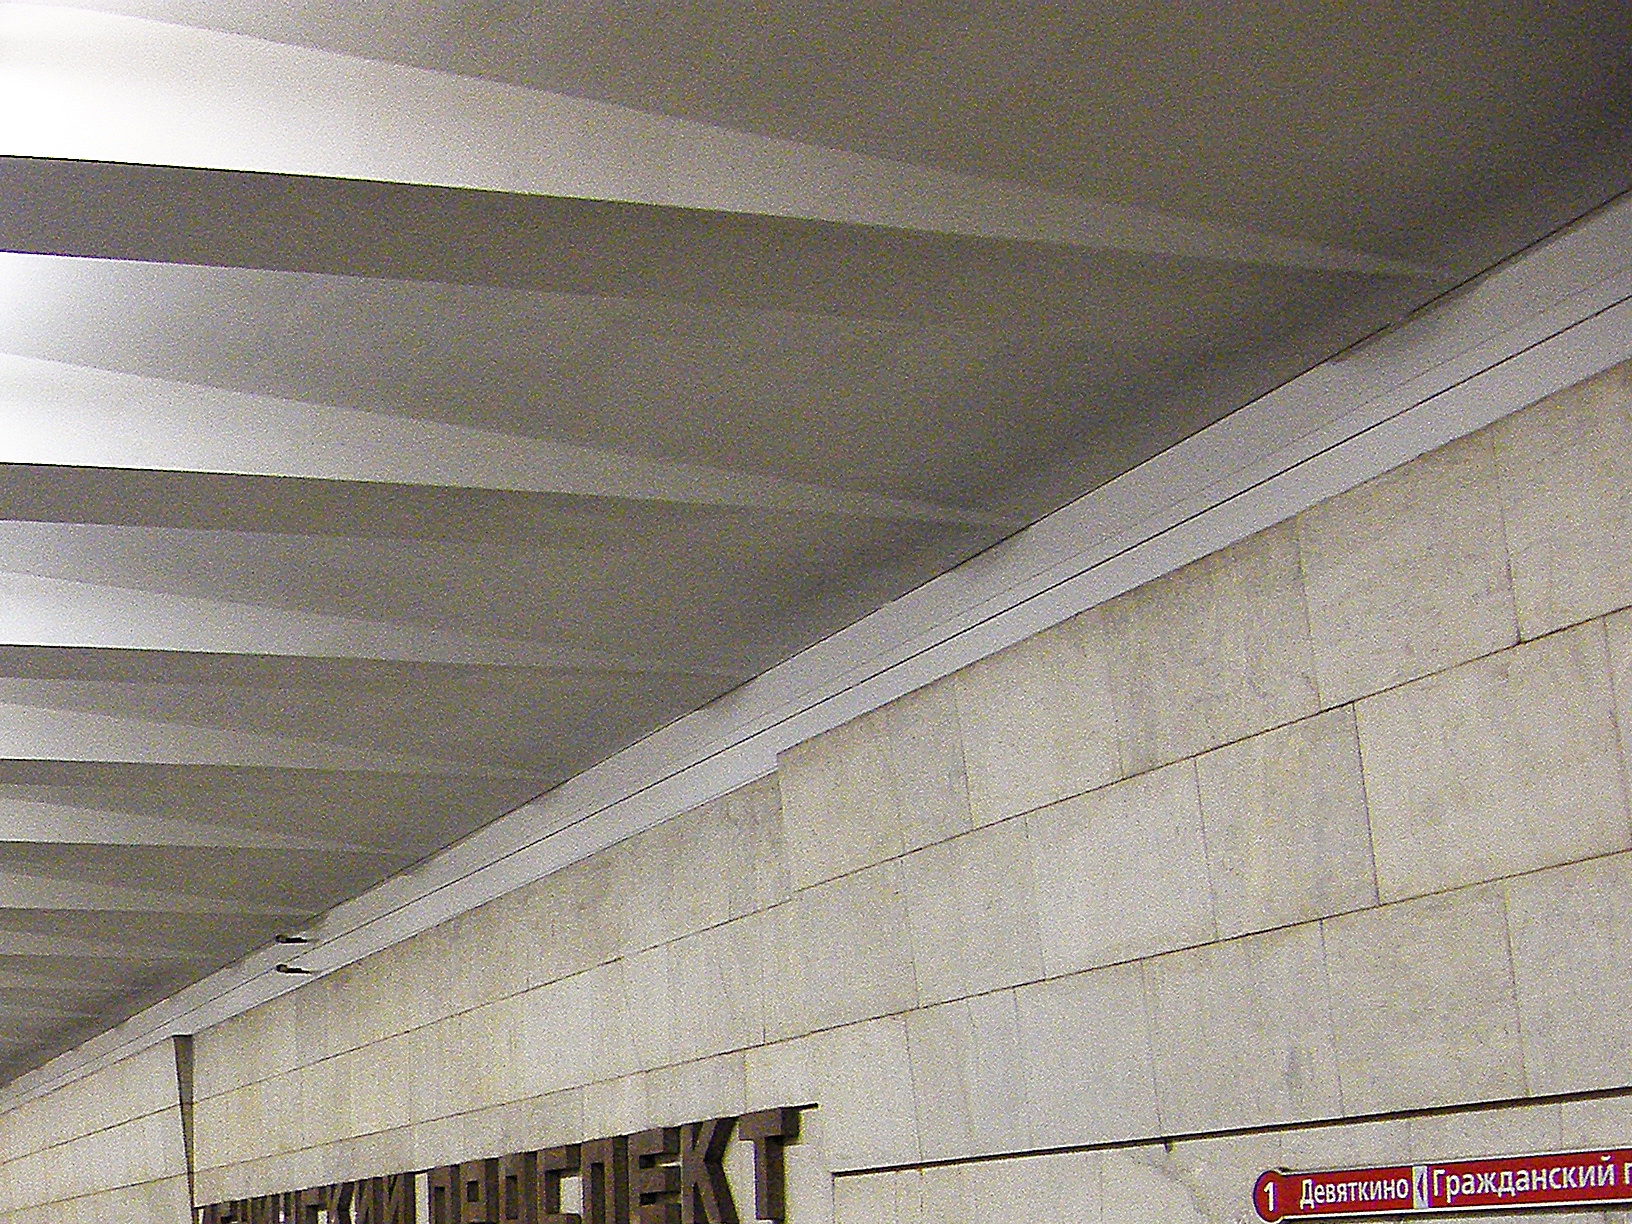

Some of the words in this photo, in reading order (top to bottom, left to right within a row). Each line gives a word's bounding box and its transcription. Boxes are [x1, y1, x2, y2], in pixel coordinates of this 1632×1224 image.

[1262, 1181, 1277, 1213] 1
[1299, 1177, 1410, 1210] Девяткино
[1432, 1154, 1616, 1204] Гражданский
